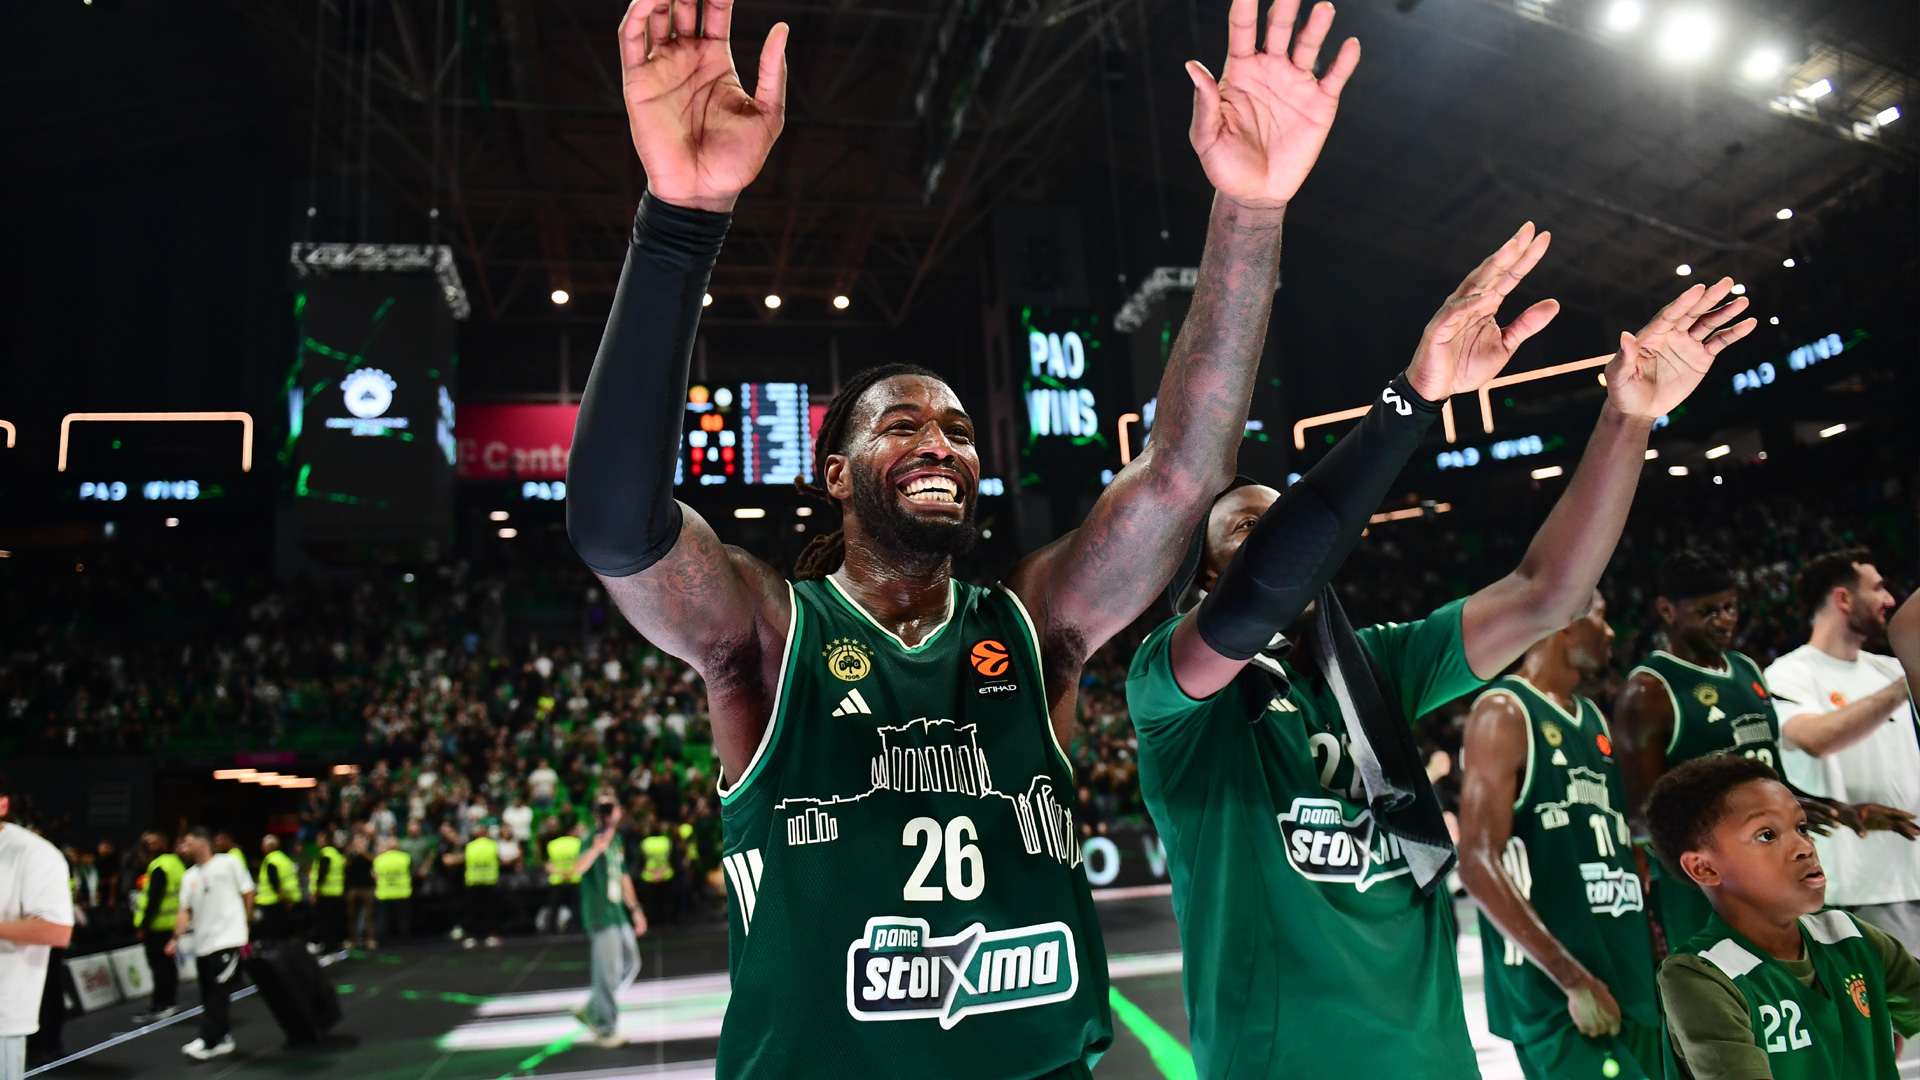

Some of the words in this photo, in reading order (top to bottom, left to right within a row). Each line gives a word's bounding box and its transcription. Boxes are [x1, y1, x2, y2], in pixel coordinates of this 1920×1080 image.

[1029, 331, 1085, 380] PAO
[1733, 362, 1776, 395] PAO
[1787, 333, 1844, 371] WINS
[1025, 388, 1099, 437] WINS
[1437, 447, 1479, 471] PAO
[1492, 434, 1544, 460] WINS
[80, 481, 128, 501] PAO
[143, 479, 200, 501] WINS
[978, 684, 1017, 694] ETIHAD
[902, 815, 985, 901] 26
[1589, 814, 1615, 857] 11
[874, 928, 918, 951] pame
[1759, 999, 1812, 1054] 22
